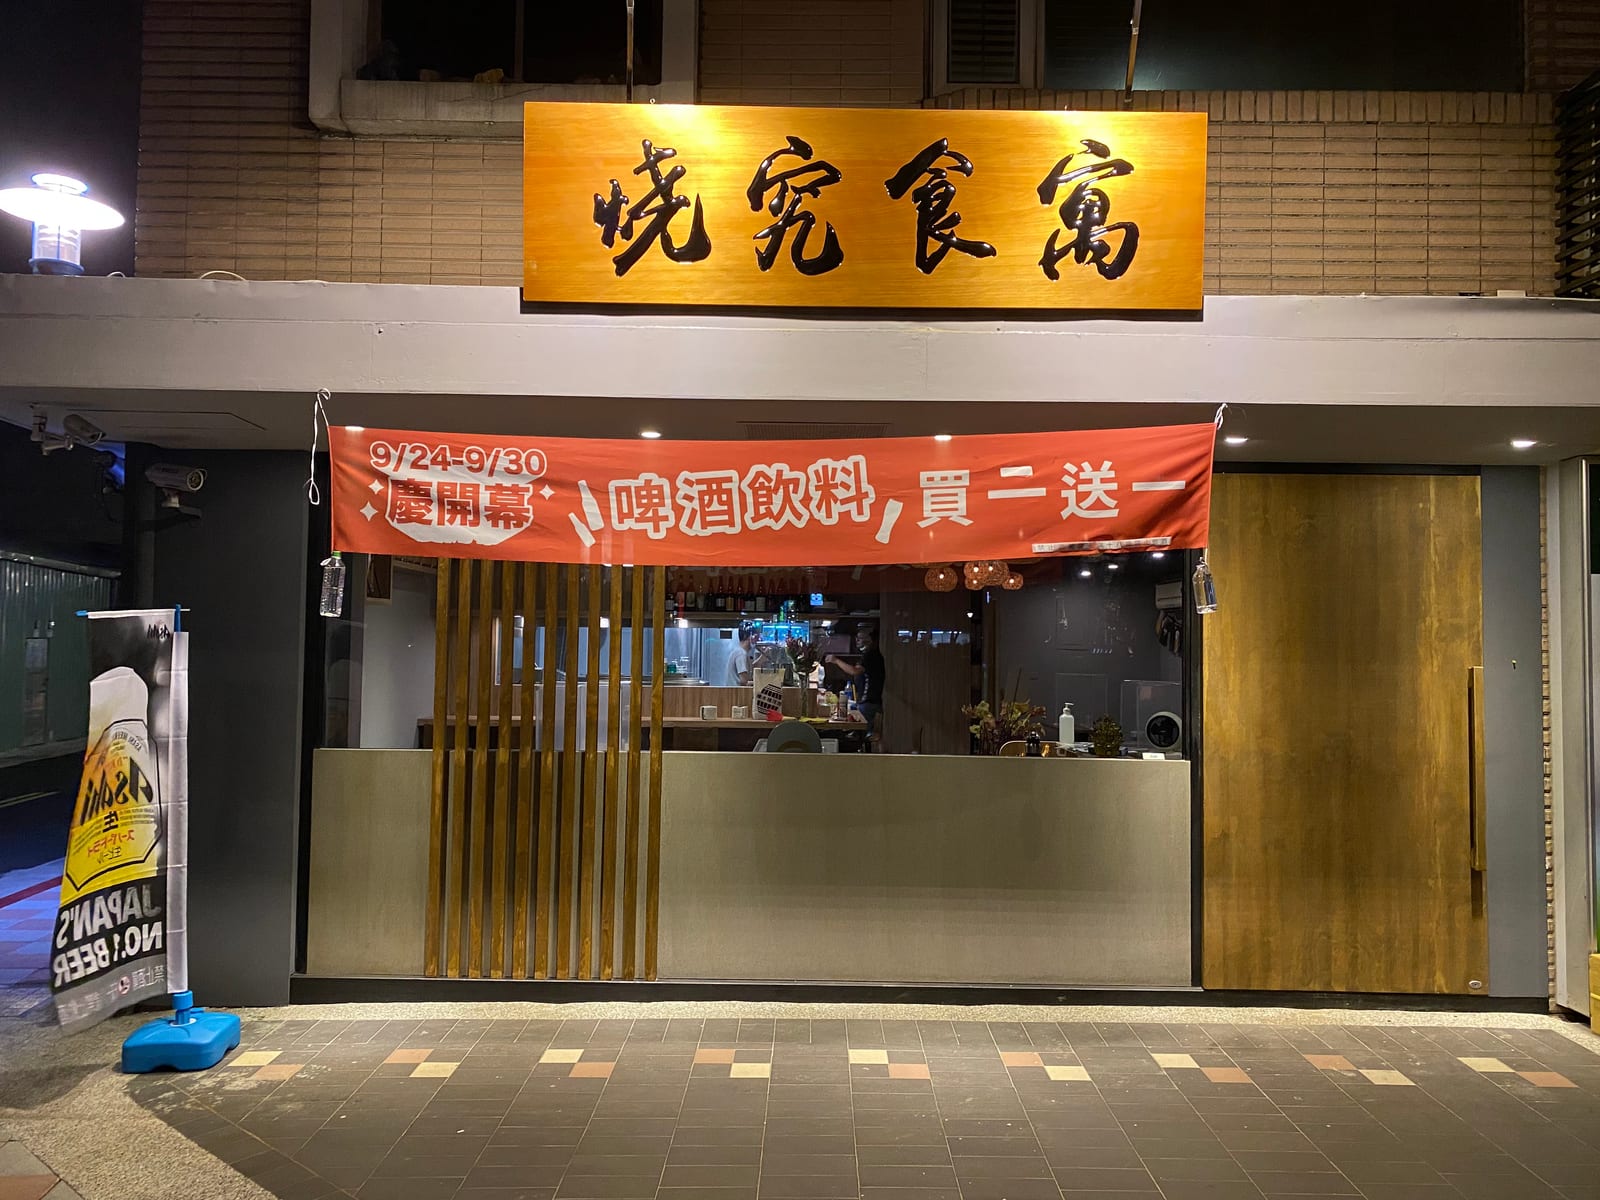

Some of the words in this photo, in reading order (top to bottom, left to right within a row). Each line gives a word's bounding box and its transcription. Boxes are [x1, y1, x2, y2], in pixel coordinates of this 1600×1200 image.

[370, 441, 547, 478] 9/24-9/30
[388, 477, 535, 531] 慶開幕
[608, 455, 876, 540] 啤酒飲料
[916, 460, 1187, 529] 買二送一
